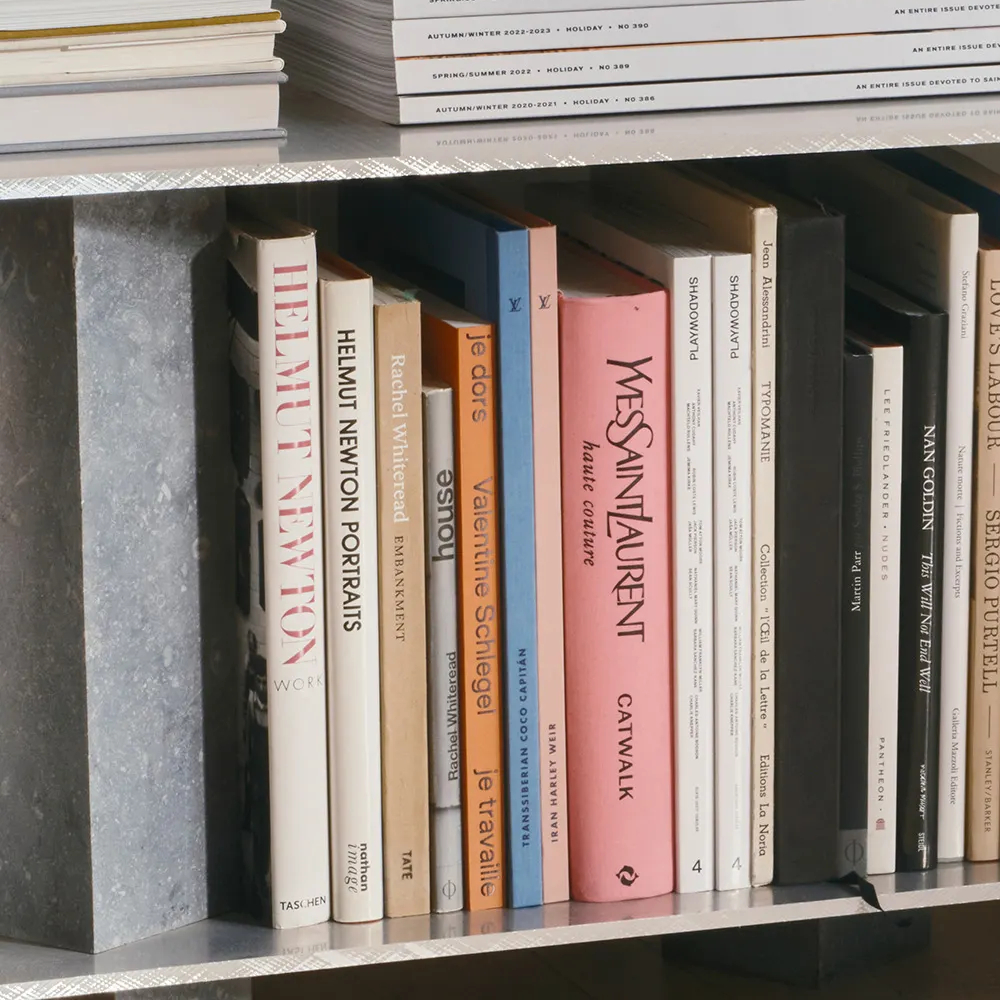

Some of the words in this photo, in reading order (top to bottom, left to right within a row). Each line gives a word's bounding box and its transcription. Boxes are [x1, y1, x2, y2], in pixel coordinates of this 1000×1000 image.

[427, 30, 501, 40] AUTUMN/WINTER
[503, 27, 551, 36] 2022-2023
[565, 24, 603, 33] HOLIDAY
[869, 81, 900, 89] ENTIRE
[901, 80, 927, 88] ISSUE
[928, 78, 968, 86] DEVOTED
[761, 239, 774, 269] Jean
[761, 275, 773, 349] Alessandrini
[272, 263, 313, 460] HELMUT
[466, 333, 491, 356] je
[336, 329, 358, 410] HELMUT
[390, 353, 409, 419] Rachel
[471, 365, 489, 423] dors
[761, 381, 772, 463] TYPOMANIE
[883, 388, 891, 414] LEE
[338, 418, 360, 513] NEWTON
[582, 439, 601, 492] haute
[923, 424, 936, 463] NAN
[392, 422, 410, 524] Whiteread
[881, 420, 891, 519] FRIEDLANDER
[432, 469, 454, 562] house
[922, 466, 935, 531] GOLDIN
[473, 477, 495, 597] Valentine
[582, 499, 597, 567] couture
[881, 534, 889, 581] NUDES
[277, 473, 317, 666] NEWTON
[340, 521, 362, 633] PORTRAITS
[760, 543, 771, 602] Collection
[851, 550, 862, 573] Parr
[921, 551, 934, 578] This
[394, 535, 406, 642] EMBANKMENT
[851, 576, 862, 612] Martin
[921, 581, 933, 610] Will
[920, 613, 932, 635] Not
[472, 605, 497, 715] Schlegel
[759, 649, 771, 664] de
[759, 668, 771, 681] la
[920, 638, 932, 662] End
[273, 674, 324, 692] WORK
[447, 651, 459, 731] Whiteread
[516, 648, 528, 703] CAPITÁN
[919, 666, 931, 693] Well
[519, 707, 529, 743] COCO
[759, 686, 771, 720] Lettre
[447, 733, 460, 782] Rachel
[548, 723, 557, 755] WEIR
[617, 693, 634, 801] CATWALK
[474, 769, 498, 792] je
[548, 760, 558, 807] HARLEY
[759, 754, 771, 798] Editions
[877, 736, 886, 802] PANTHEON
[983, 749, 993, 833] STANLEY/BARKER
[519, 747, 531, 848] TRANSSIBERIAN
[758, 802, 770, 818] La
[479, 797, 500, 897] travaille
[549, 811, 559, 843] IRAN
[758, 824, 770, 858] Noria
[344, 843, 358, 894] image
[360, 843, 368, 892] nathan
[401, 849, 414, 881] TATE
[692, 859, 702, 874] 4
